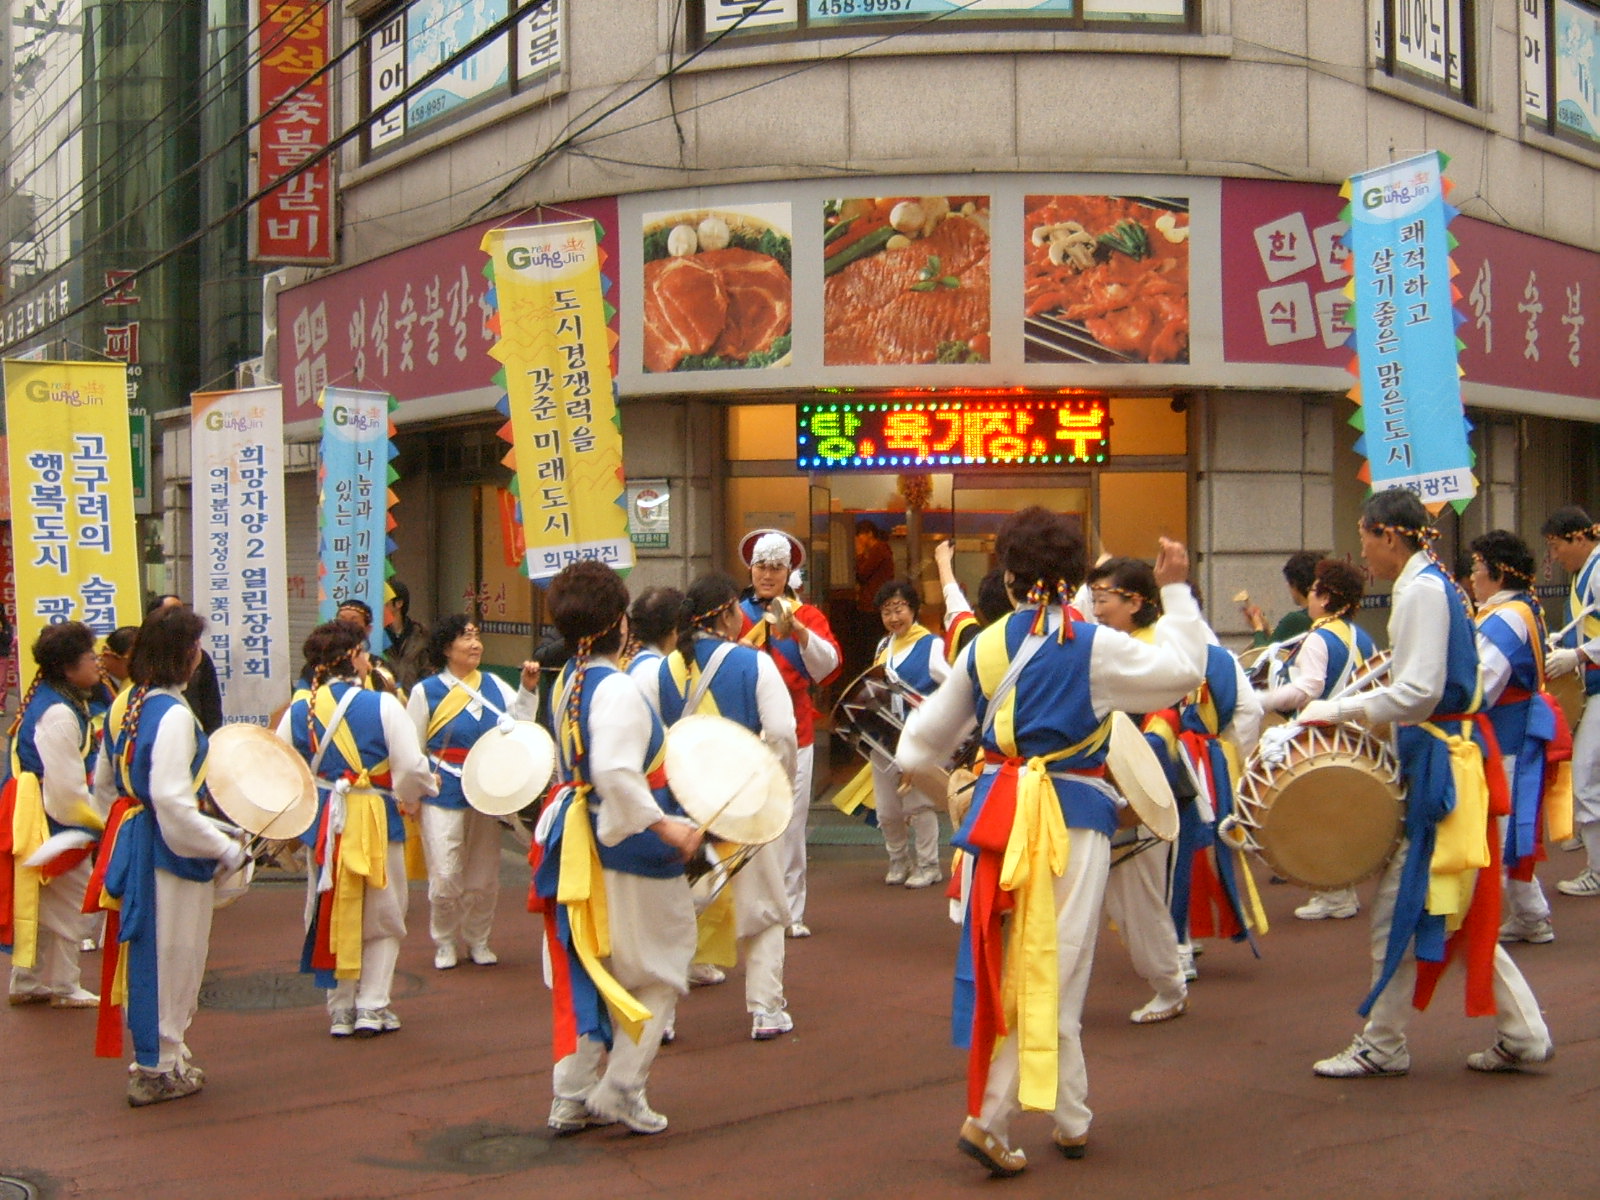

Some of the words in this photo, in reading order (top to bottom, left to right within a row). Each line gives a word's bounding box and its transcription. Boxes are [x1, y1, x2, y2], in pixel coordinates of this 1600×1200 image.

[1400, 219, 1431, 326] 쾌적하고
[527, 368, 557, 420] 갖춘
[29, 453, 69, 573] 행복도시
[72, 436, 110, 552] 고구려의
[210, 467, 229, 526] 여러분의
[335, 480, 352, 526] 있는
[356, 449, 374, 521] 나눔과
[354, 529, 371, 599] 기쁨이
[80, 577, 117, 635] 숨결
[210, 597, 230, 626] 꽃이
